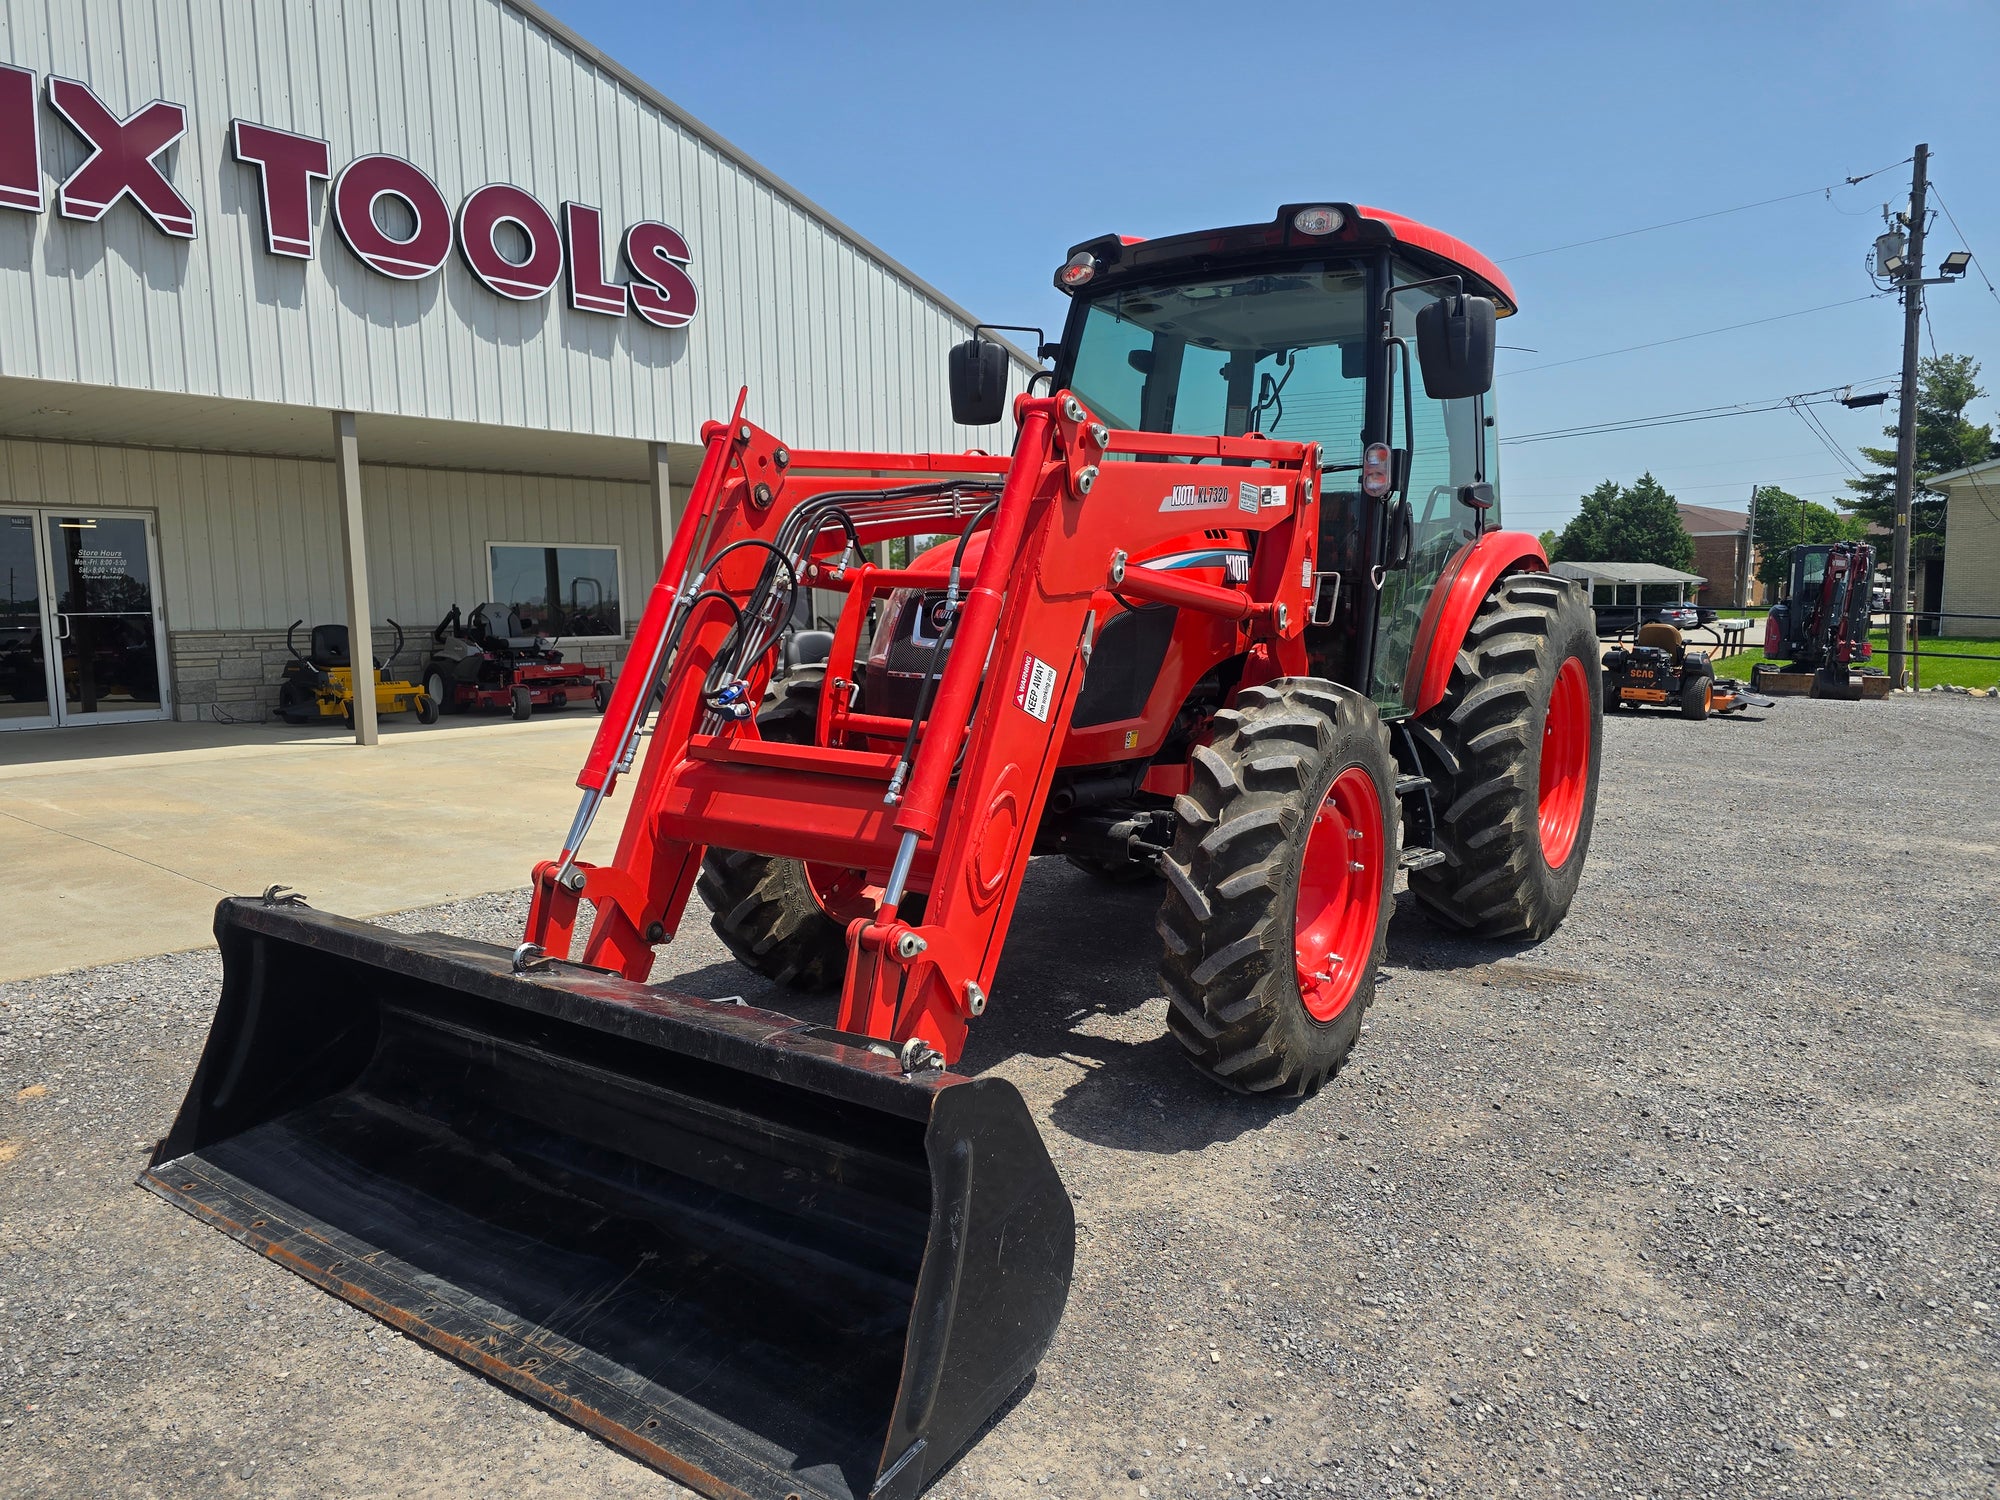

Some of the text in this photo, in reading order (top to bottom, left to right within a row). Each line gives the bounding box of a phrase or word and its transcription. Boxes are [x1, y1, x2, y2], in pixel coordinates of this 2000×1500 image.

[230, 118, 699, 329] TOOLS
[1170, 484, 1196, 506] KIOTI
[1198, 487, 1229, 503] KL7320
[1018, 655, 1032, 693] WARNING
[1027, 662, 1045, 713] KEEP AWAY
[1630, 669, 1654, 679] SCAG
[1037, 704, 1045, 718] from
[1041, 682, 1051, 704] working
